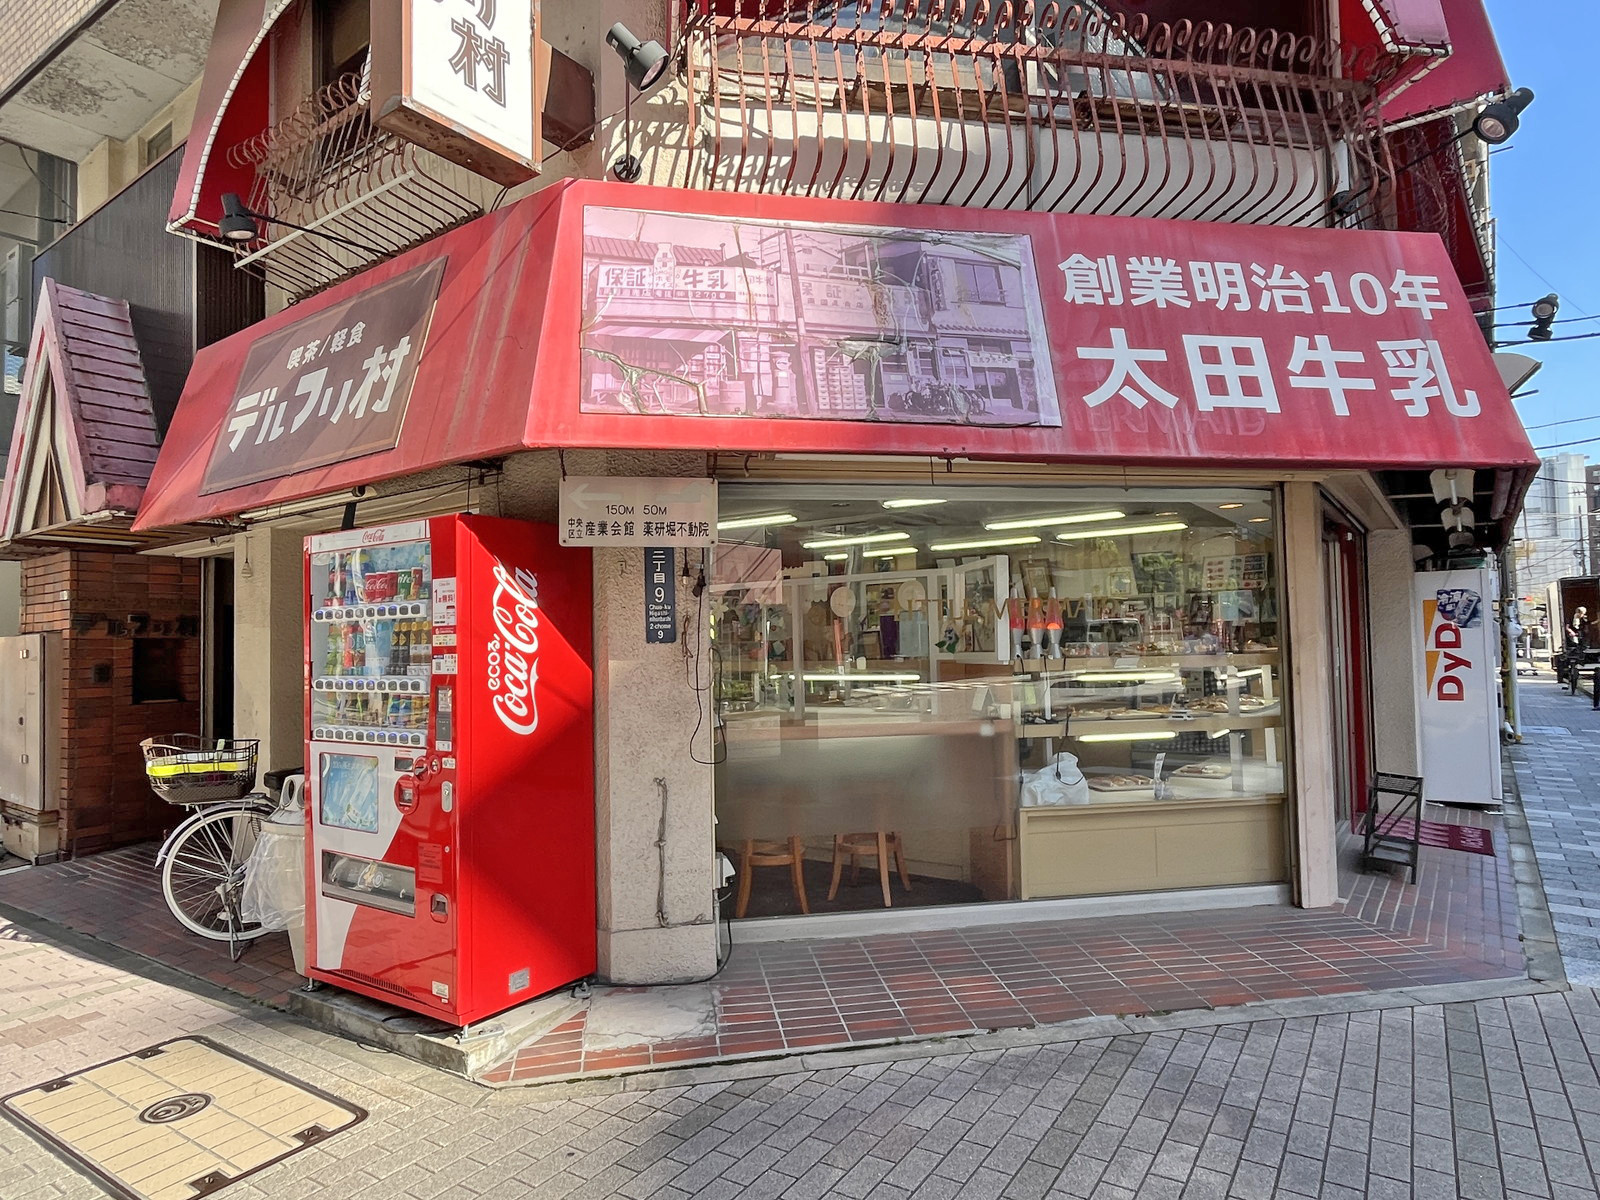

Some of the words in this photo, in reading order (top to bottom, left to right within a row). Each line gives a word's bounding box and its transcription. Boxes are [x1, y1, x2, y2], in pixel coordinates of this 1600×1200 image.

[605, 267, 646, 287] 保証
[683, 269, 729, 290] 牛乳
[1057, 253, 1449, 320] 創業明治10年
[286, 321, 366, 370] 喫茶/軽食
[1076, 327, 1482, 418] 太田牛乳
[228, 335, 411, 453] デルフリ村
[606, 505, 635, 515] 150M
[643, 505, 667, 515] 50M
[568, 518, 583, 528] 中央
[585, 521, 635, 536] 産業会館
[643, 521, 709, 537] 薬研堀不動院
[568, 529, 583, 539] 区立
[655, 587, 665, 603] 9
[657, 630, 664, 639] 9
[492, 555, 539, 736] Coca-Cola
[1435, 611, 1473, 701] DyD
